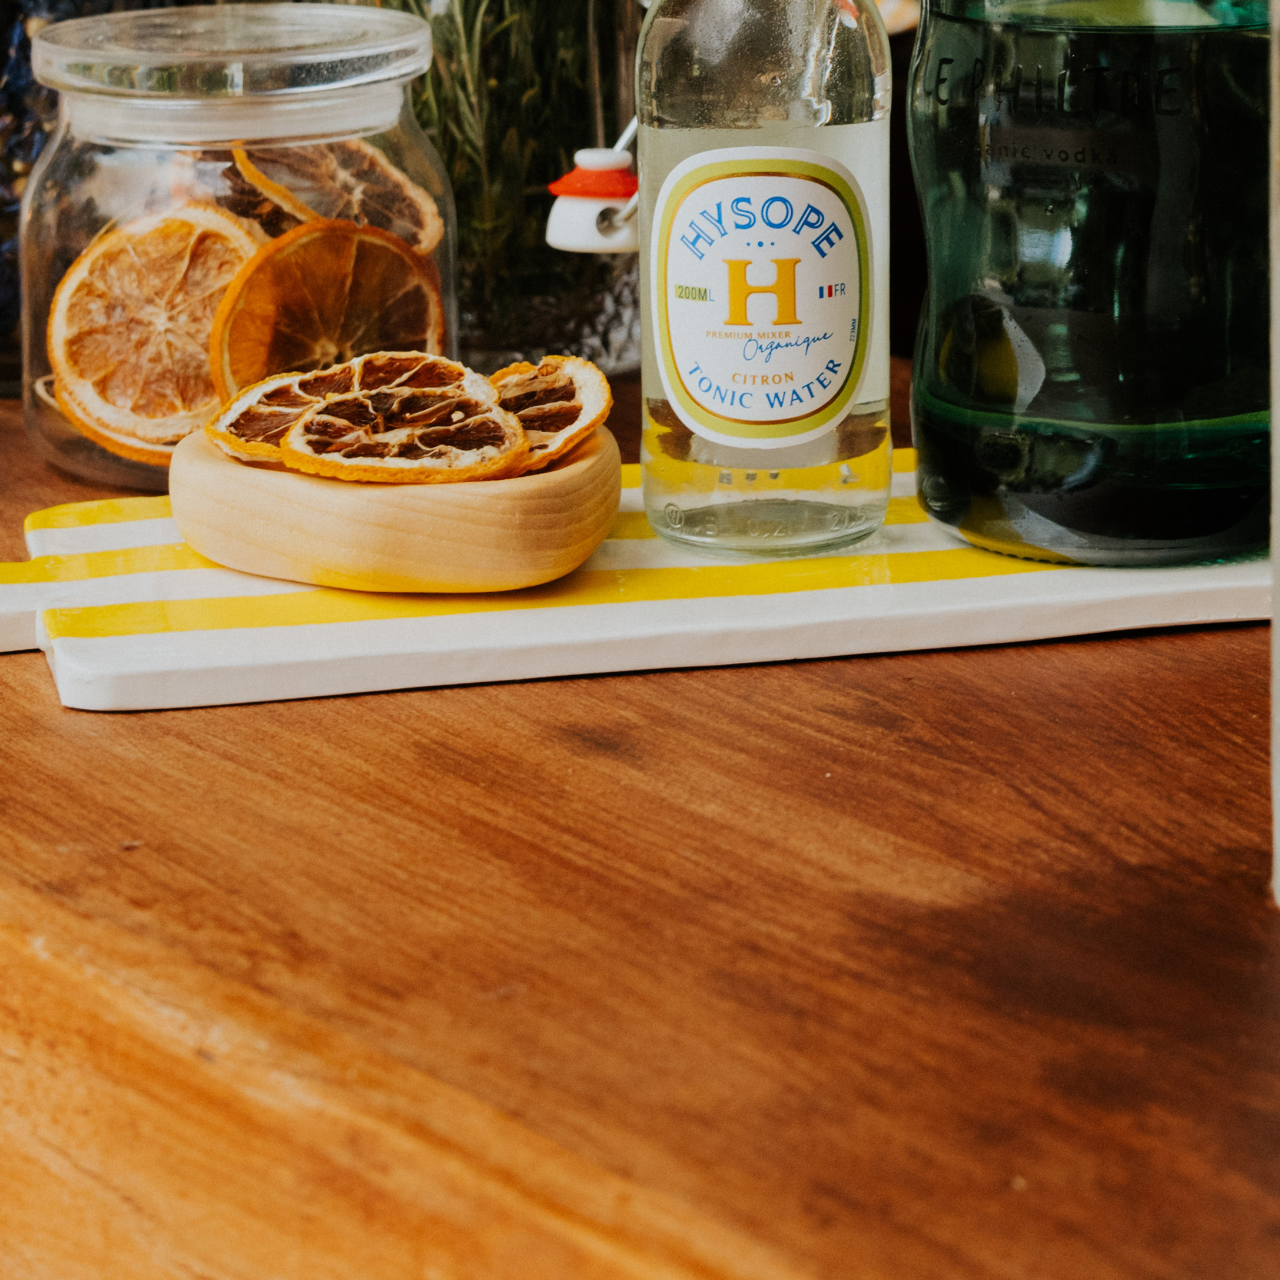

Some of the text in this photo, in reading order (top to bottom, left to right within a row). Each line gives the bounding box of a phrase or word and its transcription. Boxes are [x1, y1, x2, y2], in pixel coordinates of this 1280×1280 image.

[680, 196, 844, 261] HYSOPE
[677, 285, 715, 302] 200ML
[722, 258, 803, 326] H
[834, 282, 846, 296] FR
[706, 330, 791, 340] PREMIUM MIXER
[743, 332, 834, 363] Organique
[688, 359, 842, 409] TONIC WATER
[732, 371, 795, 386] CITRON
